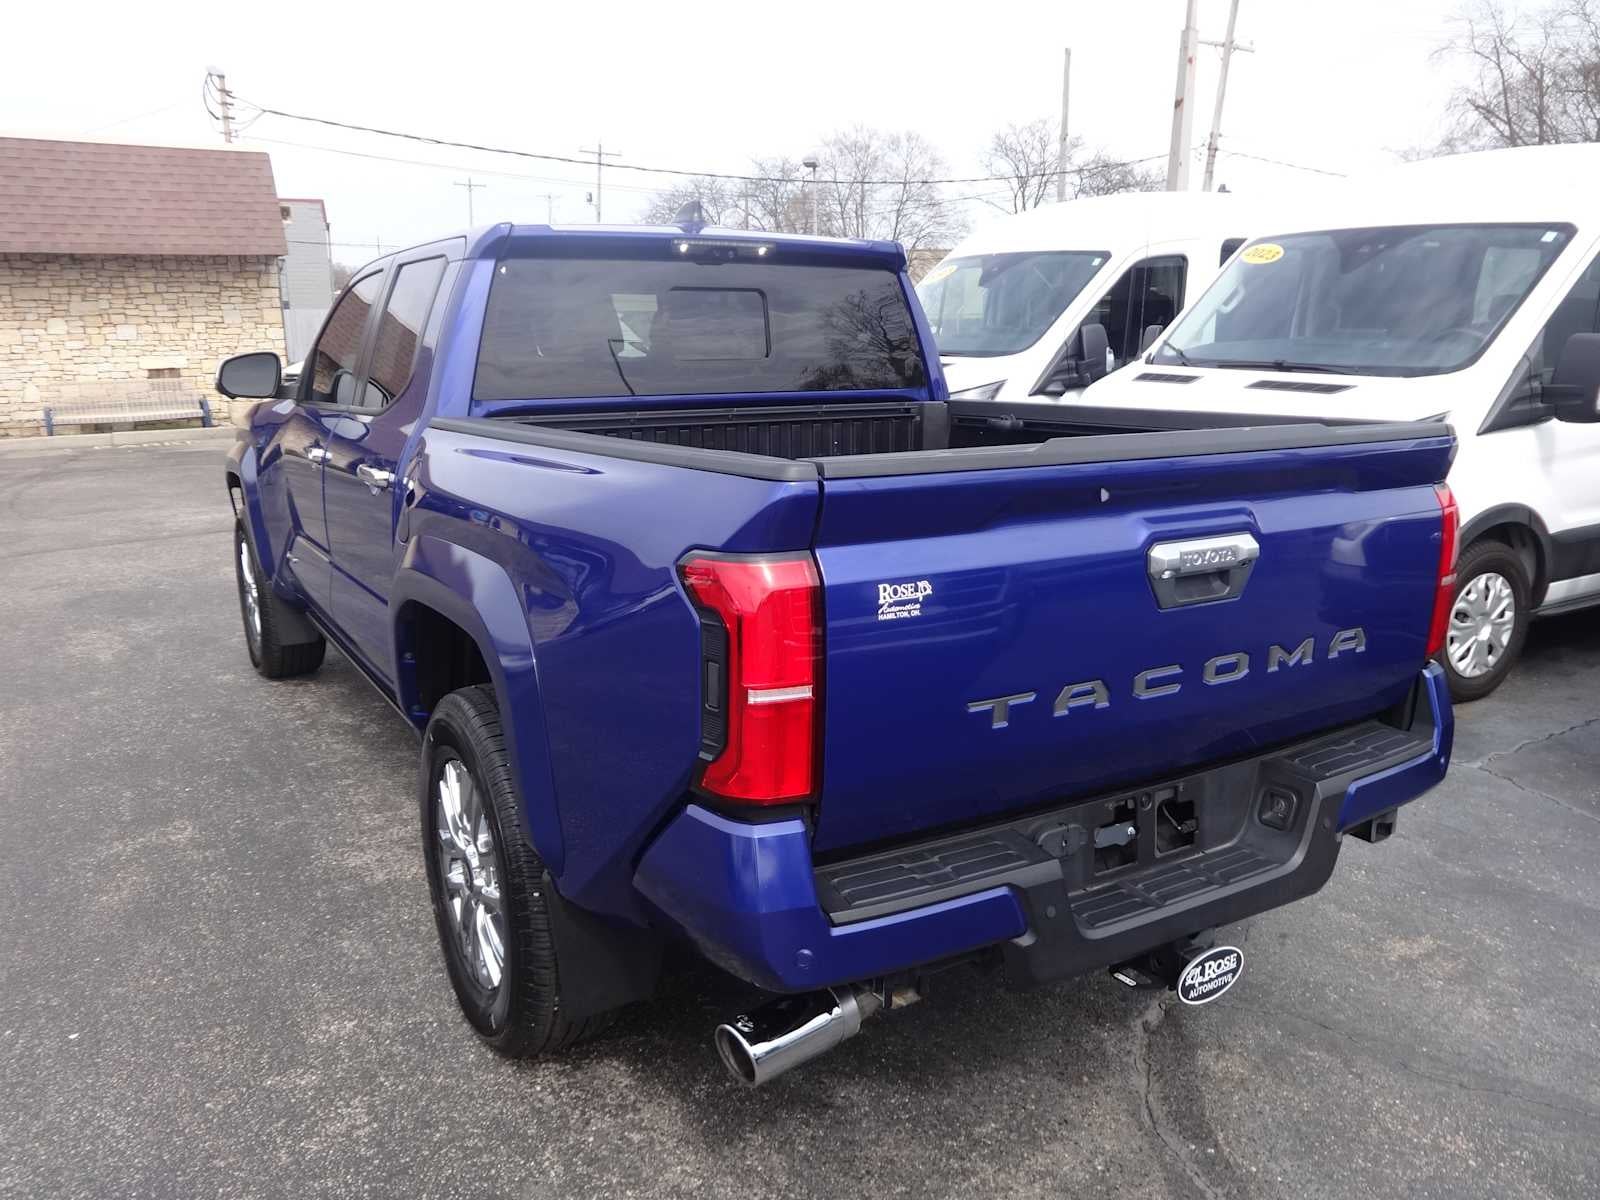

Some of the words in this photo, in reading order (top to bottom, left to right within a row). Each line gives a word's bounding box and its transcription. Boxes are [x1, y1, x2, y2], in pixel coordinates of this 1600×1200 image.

[1183, 549, 1236, 567] TOYOTA
[878, 583, 915, 604] ROSE
[967, 627, 1366, 729] TACOMA
[1203, 953, 1238, 982] ROSE
[1188, 972, 1234, 999] AUTOMOTIVE
